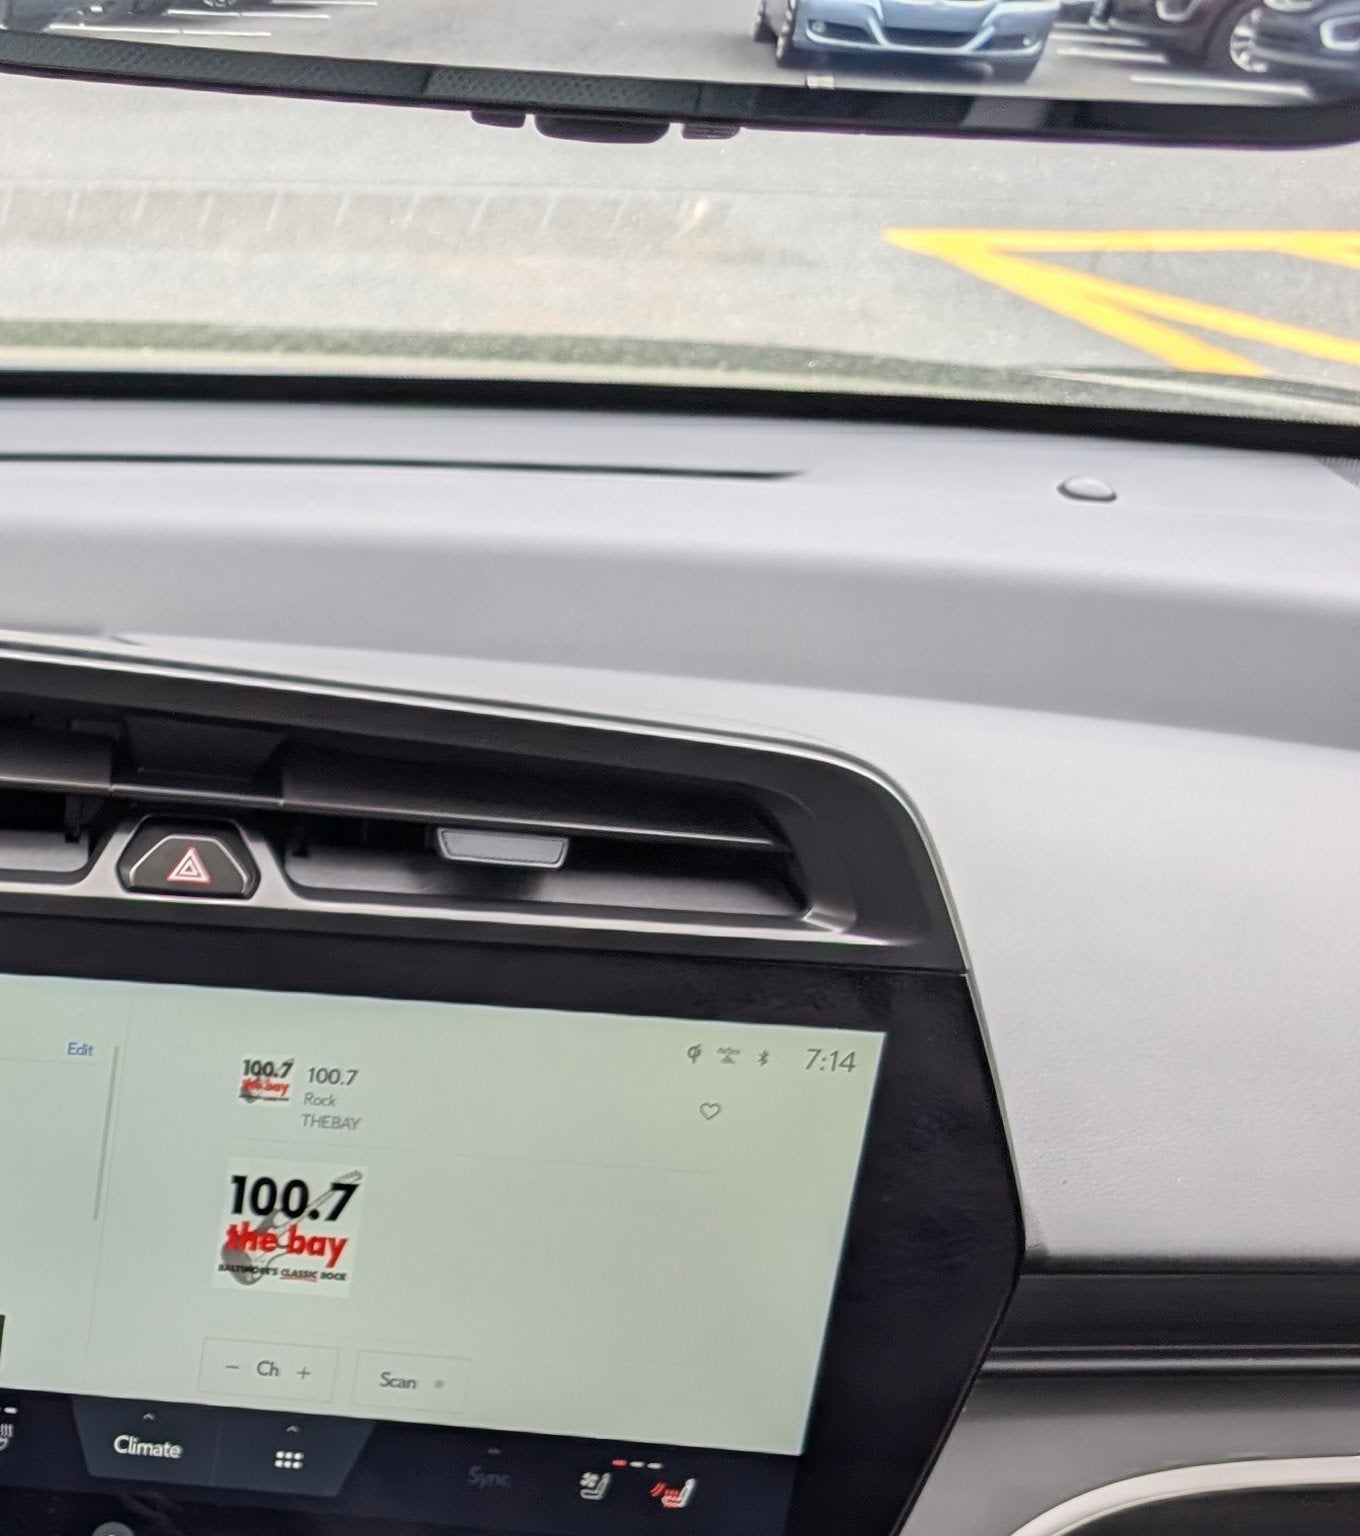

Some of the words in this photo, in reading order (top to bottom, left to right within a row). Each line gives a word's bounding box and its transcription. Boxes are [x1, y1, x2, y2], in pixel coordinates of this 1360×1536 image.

[66, 1041, 94, 1057] Edit
[242, 1058, 294, 1078] 100.7
[804, 1047, 857, 1073] 7:14
[308, 1066, 360, 1086] 100.7
[303, 1092, 337, 1107] Rock
[301, 1113, 362, 1130] THEBAY
[230, 1174, 361, 1221] 100.7
[225, 1221, 278, 1252] the
[287, 1223, 349, 1268] bay
[281, 1268, 318, 1279] CLASSIC
[257, 1360, 280, 1378] Ch
[379, 1373, 417, 1391] Scan
[113, 1435, 183, 1460] Climate
[468, 1466, 511, 1489] Sync
